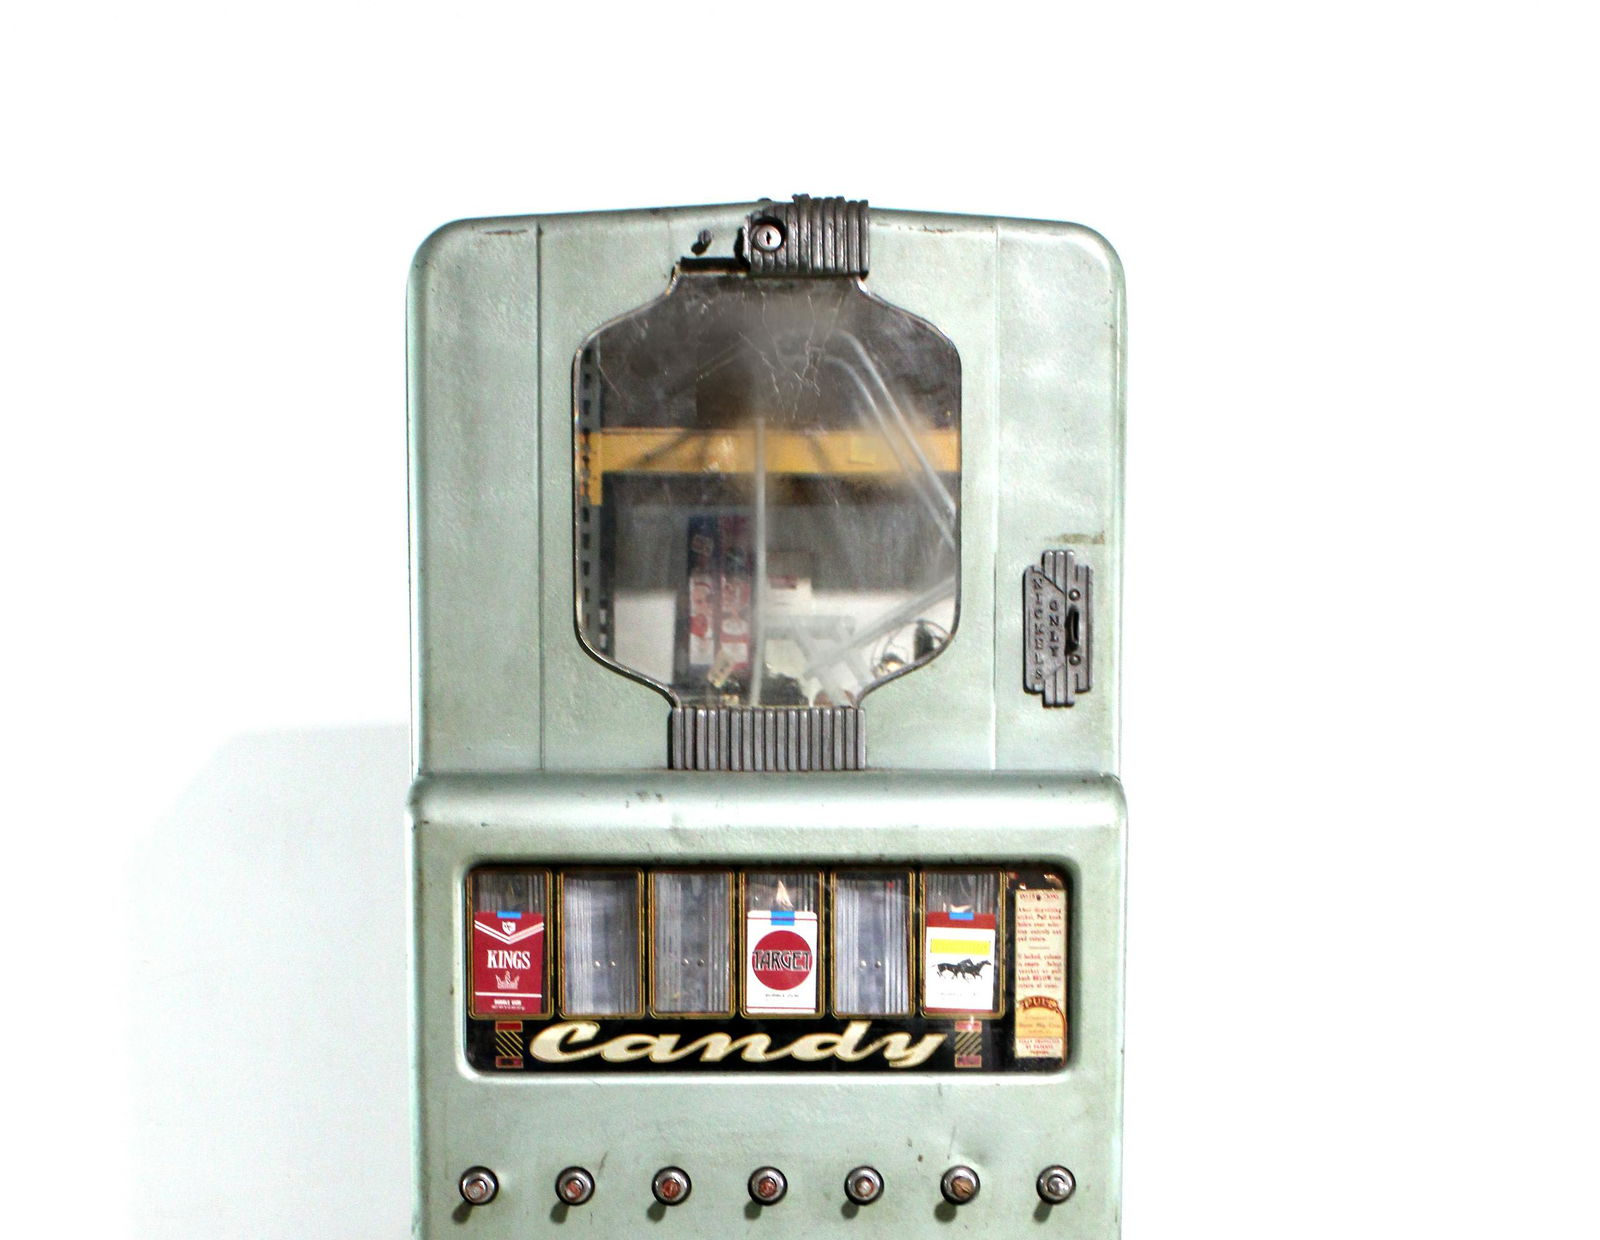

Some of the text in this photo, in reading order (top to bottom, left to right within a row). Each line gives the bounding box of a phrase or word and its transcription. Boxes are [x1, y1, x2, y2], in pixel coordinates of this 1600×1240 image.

[1032, 577, 1045, 681] NICKELS
[1048, 599, 1061, 658] ONLY
[486, 949, 532, 970] KINGS
[753, 949, 813, 972] TARGET
[529, 1020, 949, 1068] Candy
